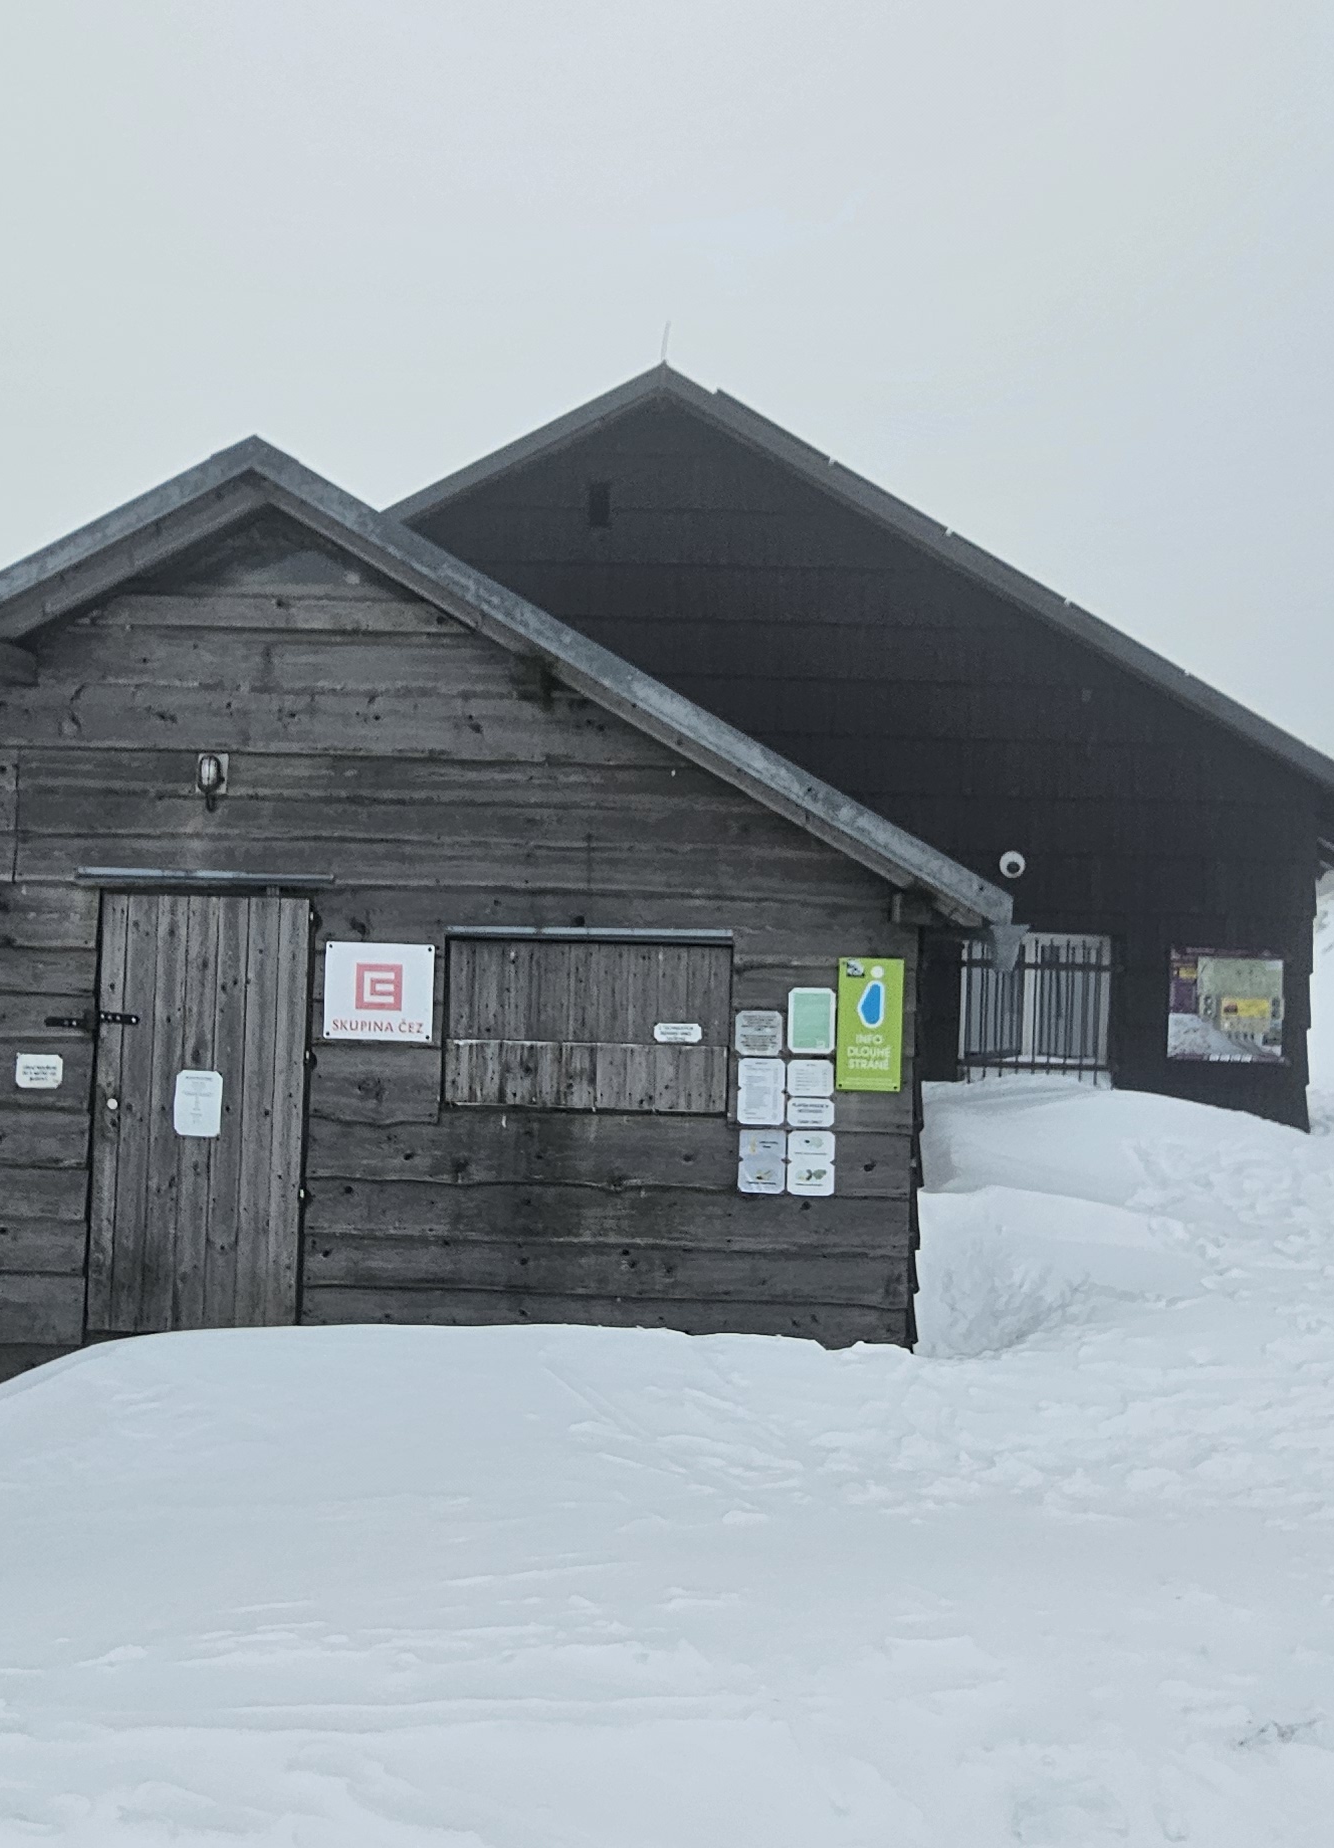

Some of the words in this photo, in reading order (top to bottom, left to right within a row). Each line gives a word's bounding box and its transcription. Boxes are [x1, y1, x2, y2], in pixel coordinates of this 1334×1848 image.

[332, 1018, 395, 1033] SKUPINA
[398, 1018, 424, 1034] ČEZ
[855, 1033, 883, 1045] INFO
[847, 1045, 891, 1058] DLOUHÉ
